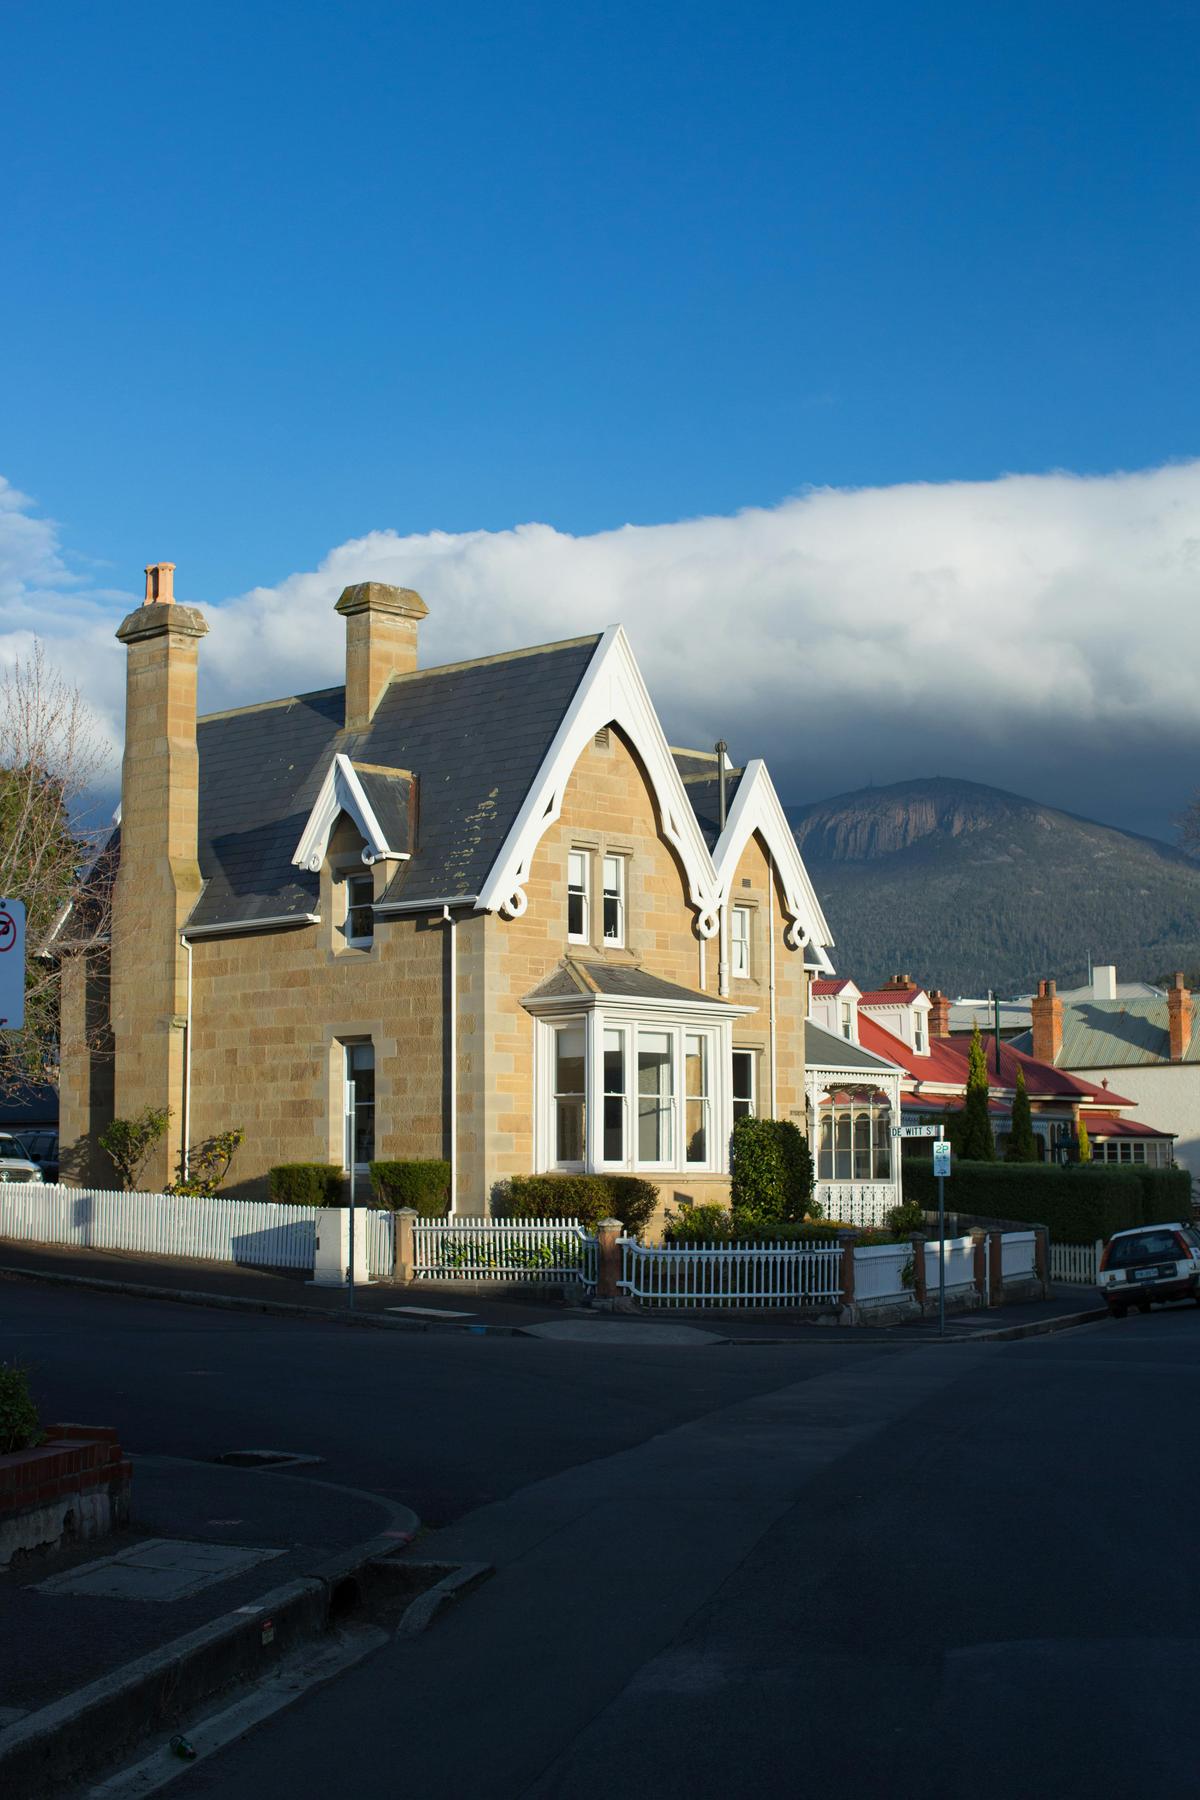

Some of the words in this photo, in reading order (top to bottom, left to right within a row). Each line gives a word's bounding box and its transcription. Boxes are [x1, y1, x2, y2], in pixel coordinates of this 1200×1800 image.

[892, 1127, 902, 1136] DE
[905, 1127, 922, 1136] WITT
[935, 1145, 949, 1154] 2P
